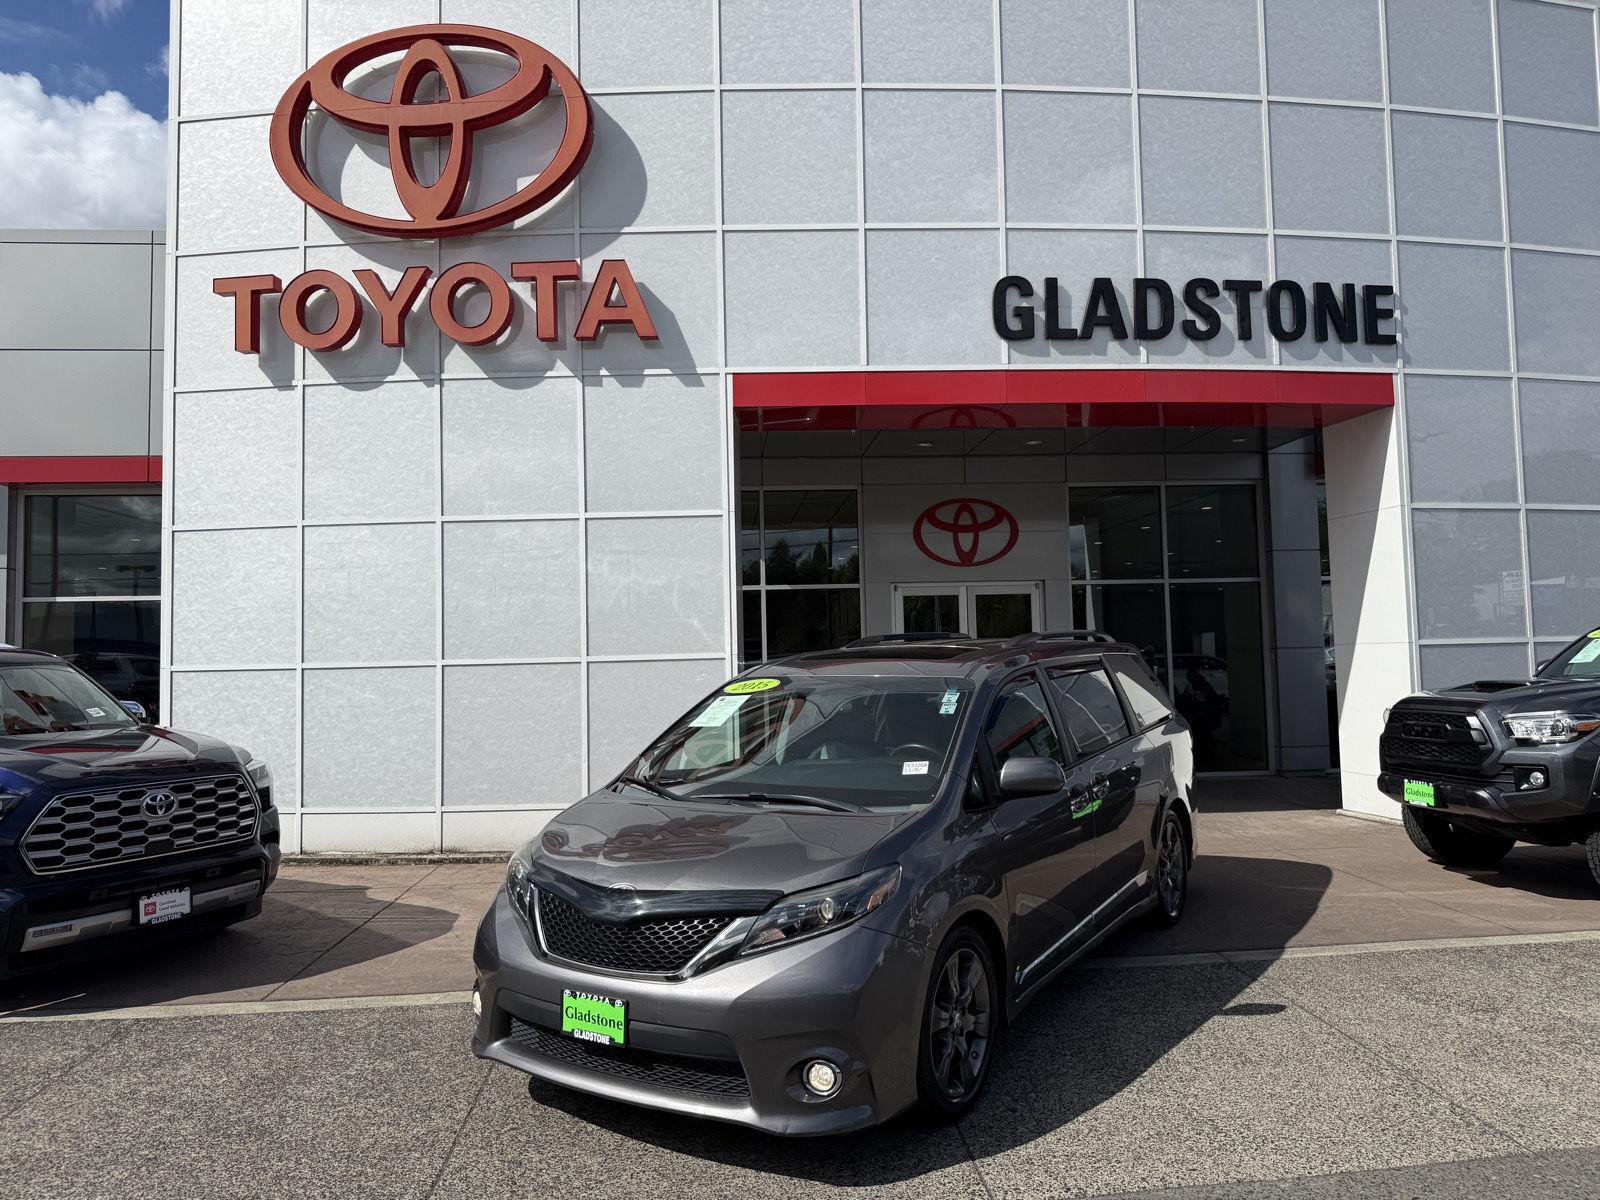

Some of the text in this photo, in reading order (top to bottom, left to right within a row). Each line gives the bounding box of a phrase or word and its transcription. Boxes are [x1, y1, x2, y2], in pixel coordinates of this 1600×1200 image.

[213, 259, 659, 354] TOYOTA
[993, 276, 1398, 345] GLADSTONE
[151, 889, 180, 897] TOYOTA
[151, 913, 181, 924] GLADSTONE
[576, 991, 610, 1003] TOYOTA
[565, 1006, 623, 1030] Gladstone
[574, 1029, 610, 1045] GLADSTONE
